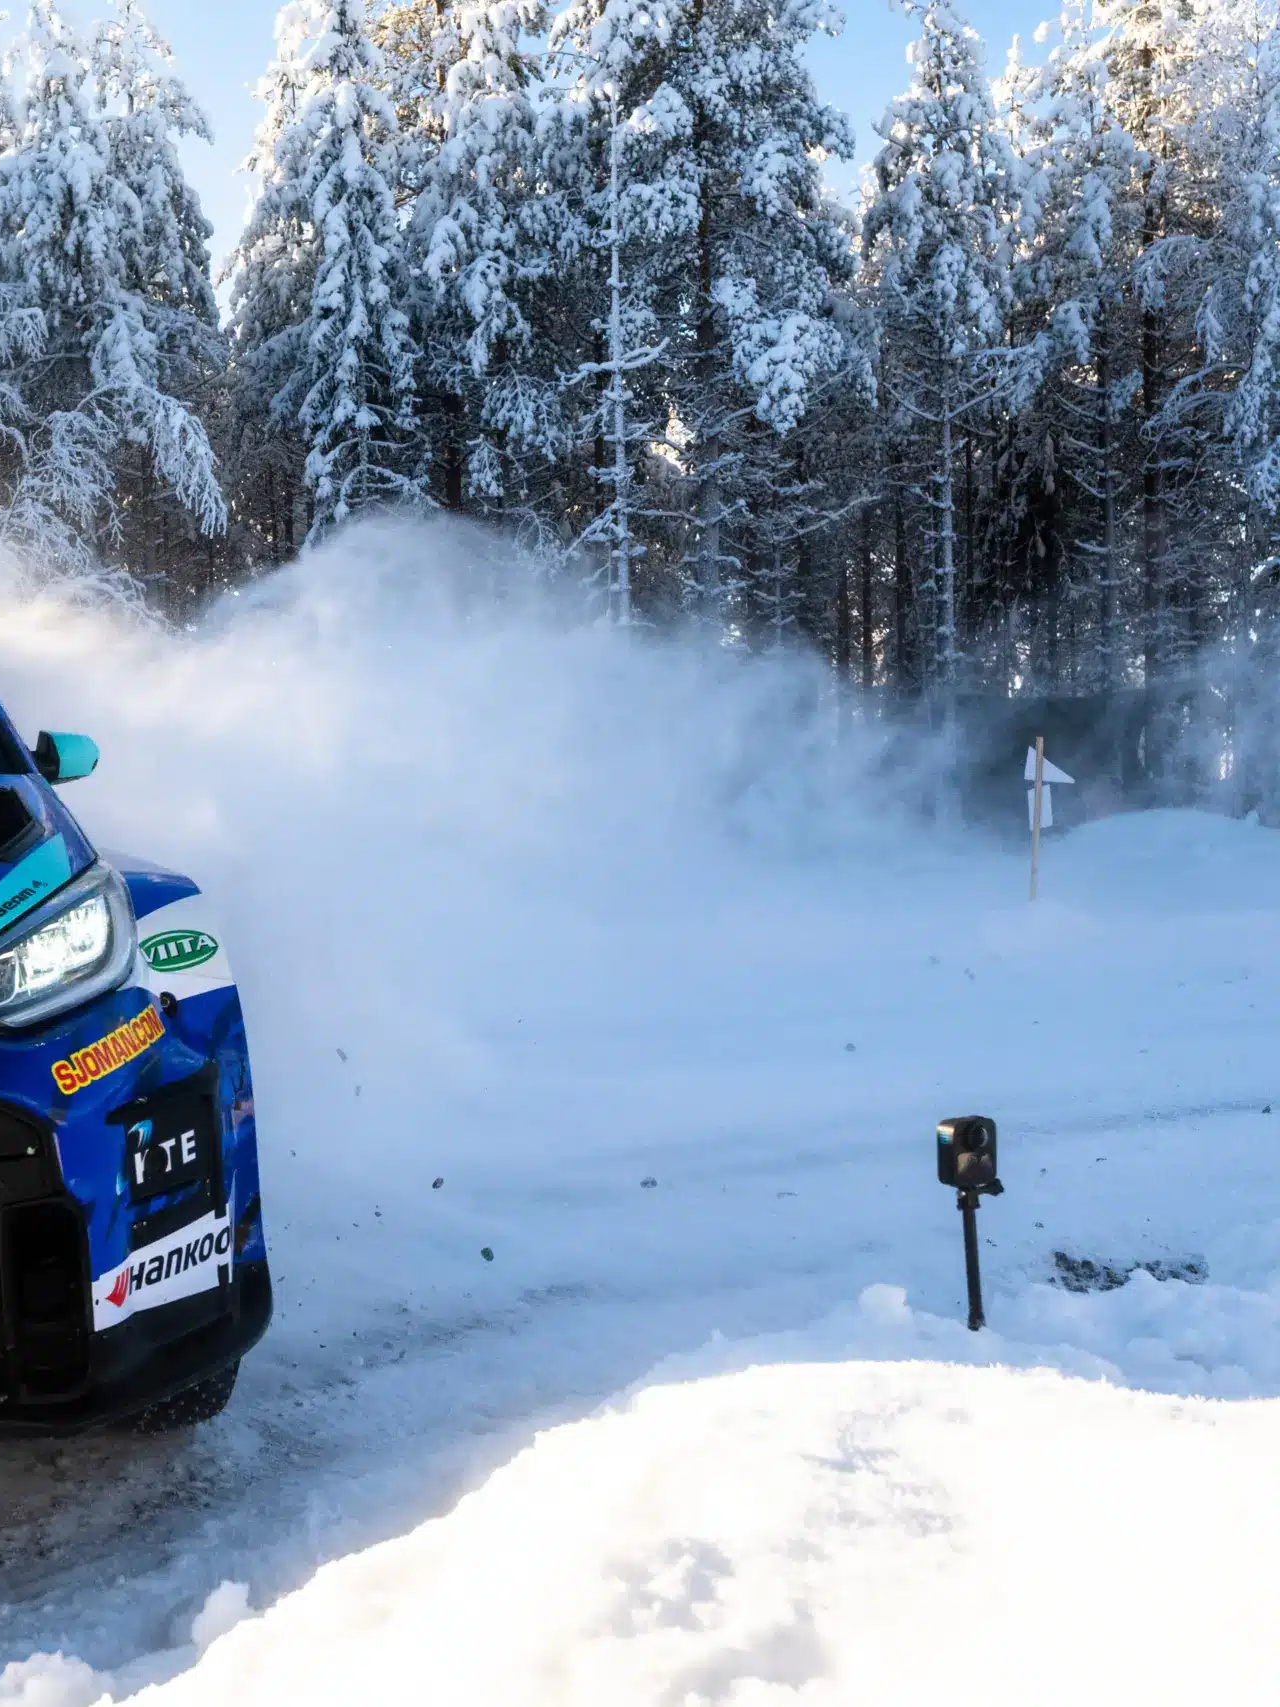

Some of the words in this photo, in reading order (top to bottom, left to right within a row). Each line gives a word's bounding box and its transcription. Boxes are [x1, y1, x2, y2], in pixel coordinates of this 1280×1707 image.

[140, 934, 217, 963] VIITA
[52, 1004, 166, 1095] SJOMAN.COM
[128, 1226, 231, 1296] Hankoo
